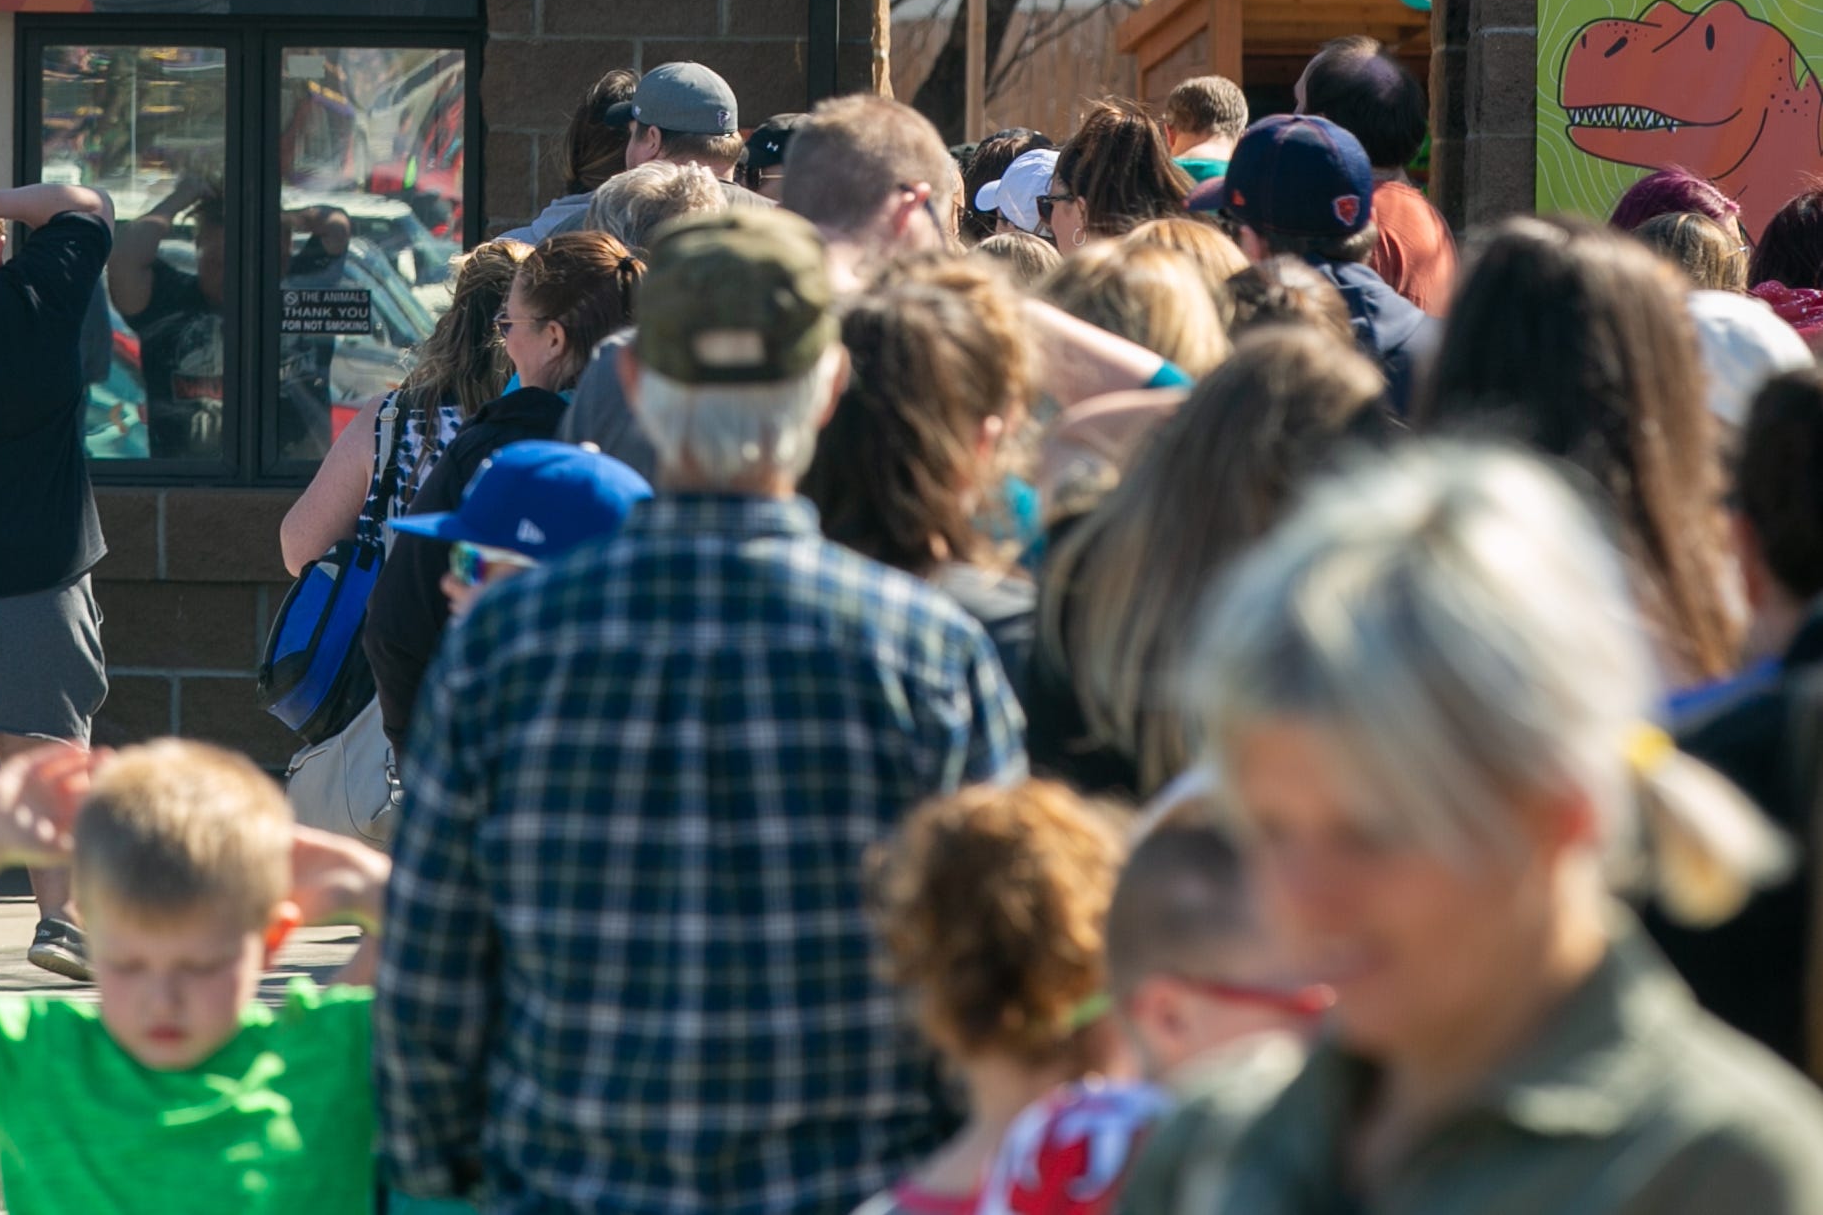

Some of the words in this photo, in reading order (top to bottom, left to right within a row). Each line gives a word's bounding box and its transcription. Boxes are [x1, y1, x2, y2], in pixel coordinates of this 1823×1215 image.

[301, 292, 319, 303] THE
[323, 292, 368, 303] ANIMALS
[283, 307, 332, 318] THANK
[338, 307, 369, 318] YOU
[282, 320, 301, 331] FOR
[304, 320, 323, 331] NOT
[325, 320, 369, 331] SMOKING
